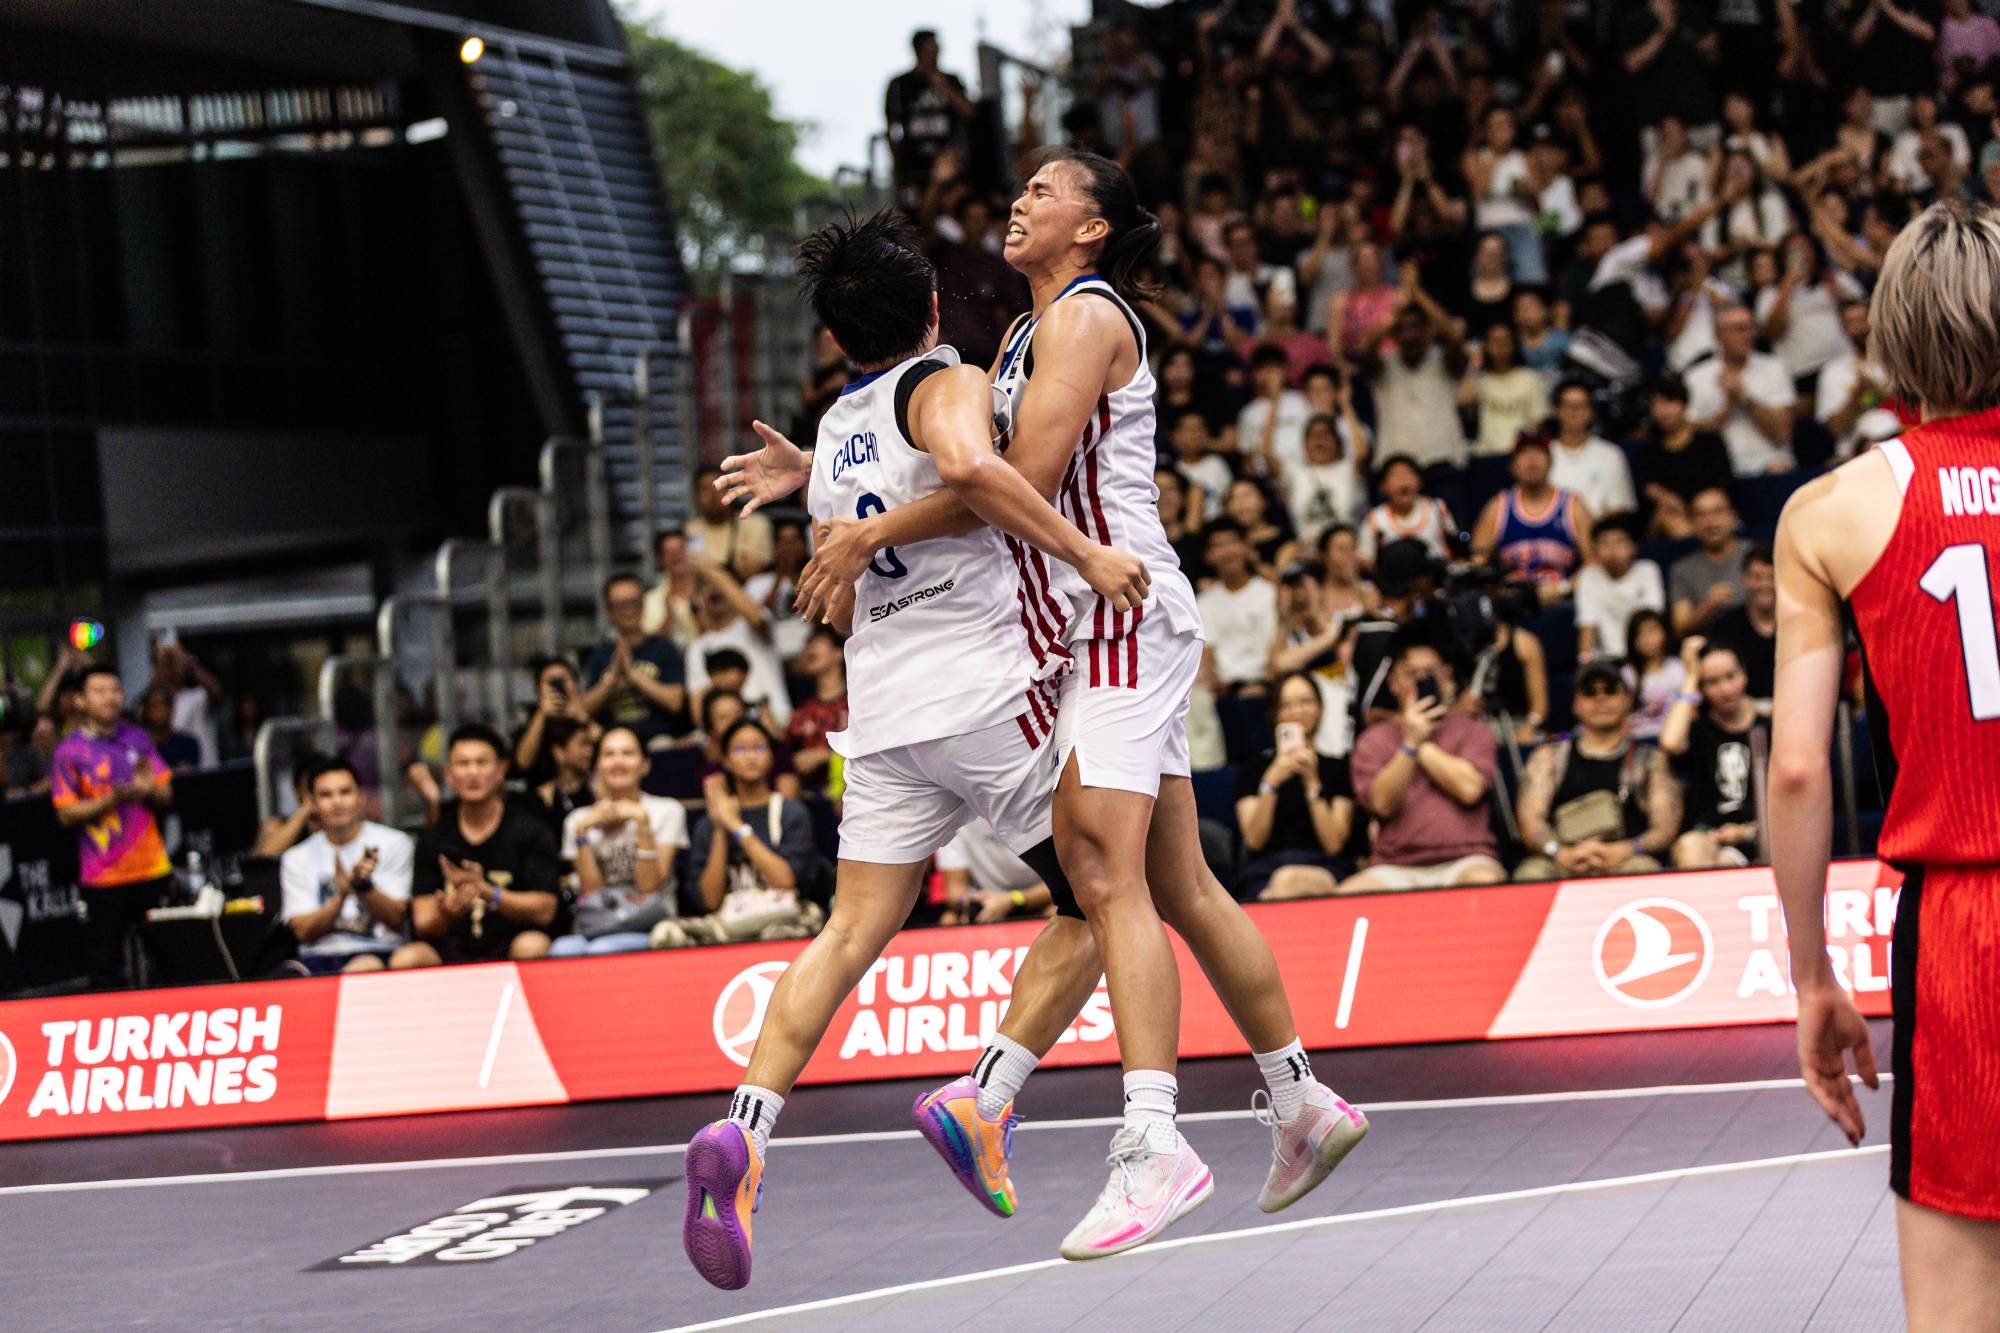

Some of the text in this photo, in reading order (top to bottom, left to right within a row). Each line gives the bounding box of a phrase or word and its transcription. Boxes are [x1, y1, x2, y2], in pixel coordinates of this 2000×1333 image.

[869, 579, 955, 623] SEASTRONG
[41, 1004, 283, 1067] TURKISH
[27, 1054, 279, 1118] AIRLINES
